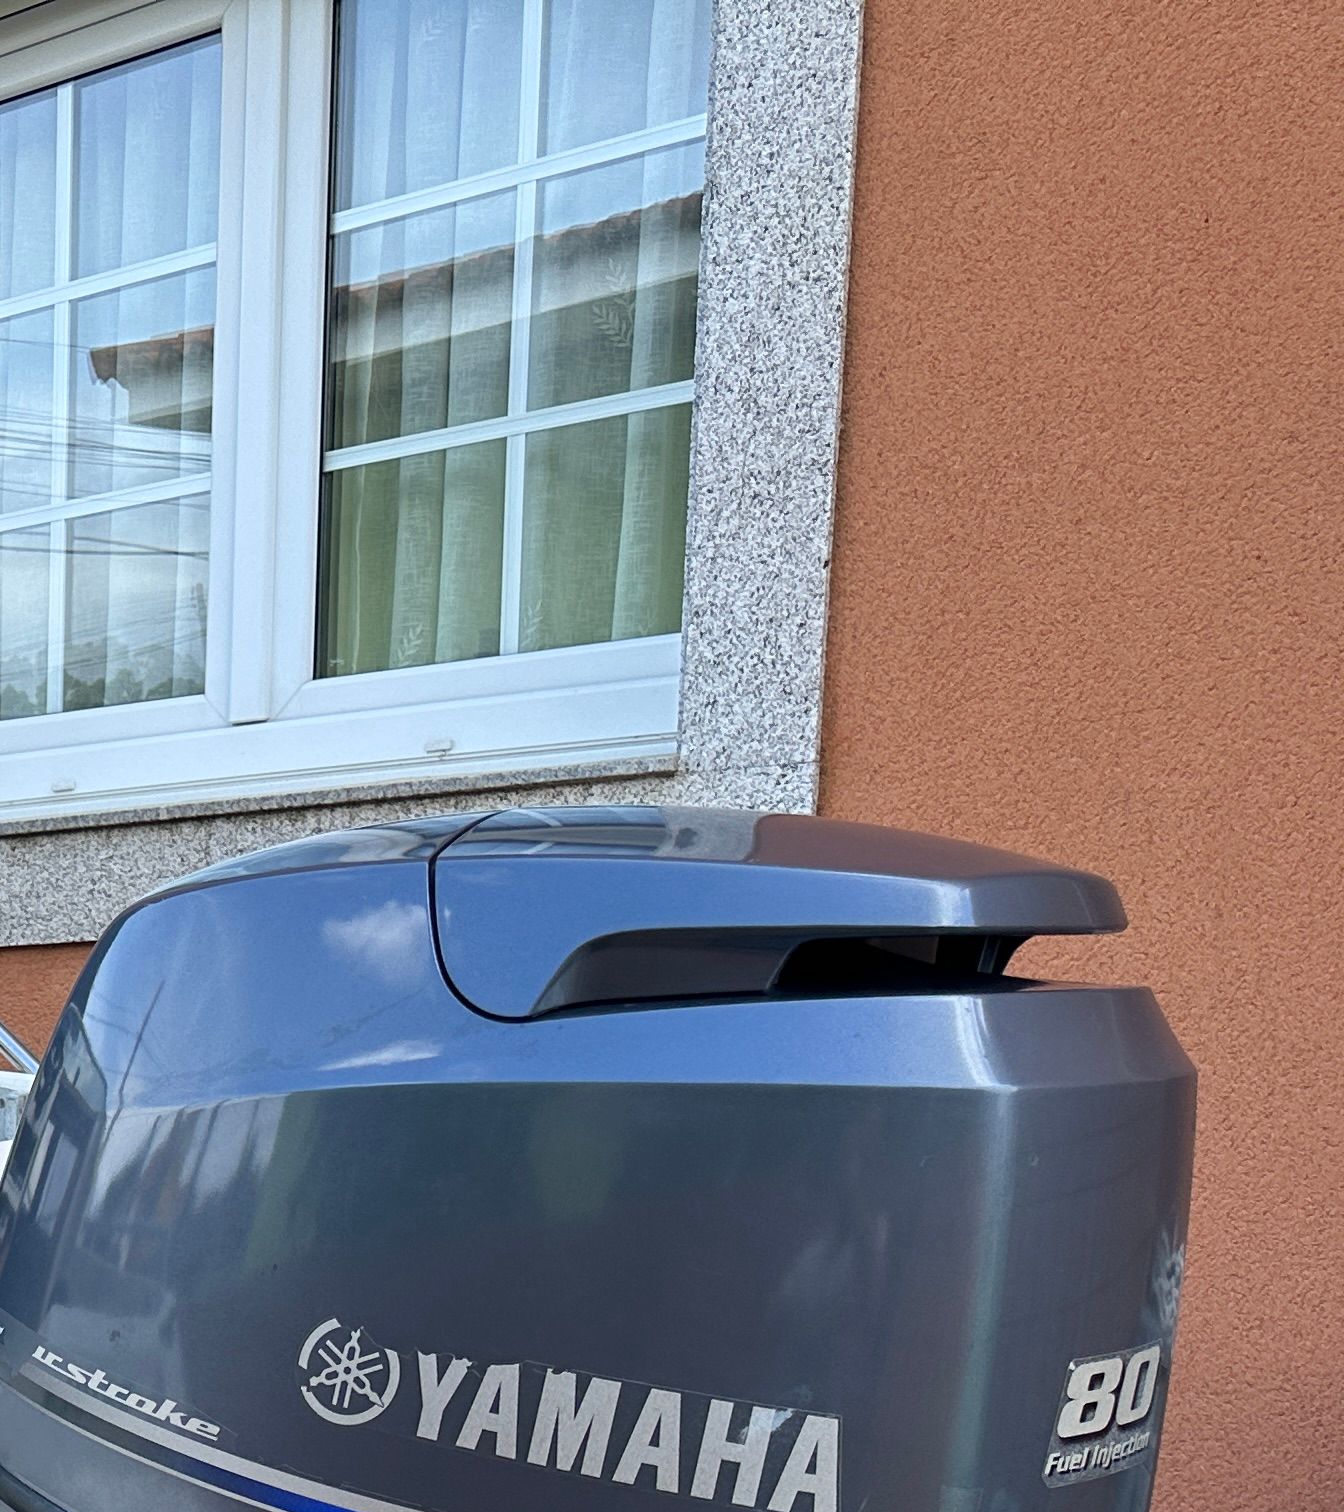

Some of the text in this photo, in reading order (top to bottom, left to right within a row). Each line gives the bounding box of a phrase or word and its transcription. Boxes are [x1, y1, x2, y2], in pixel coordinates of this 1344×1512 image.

[1056, 1345, 1161, 1438] 80
[1044, 1431, 1150, 1476] Fuel Injection
